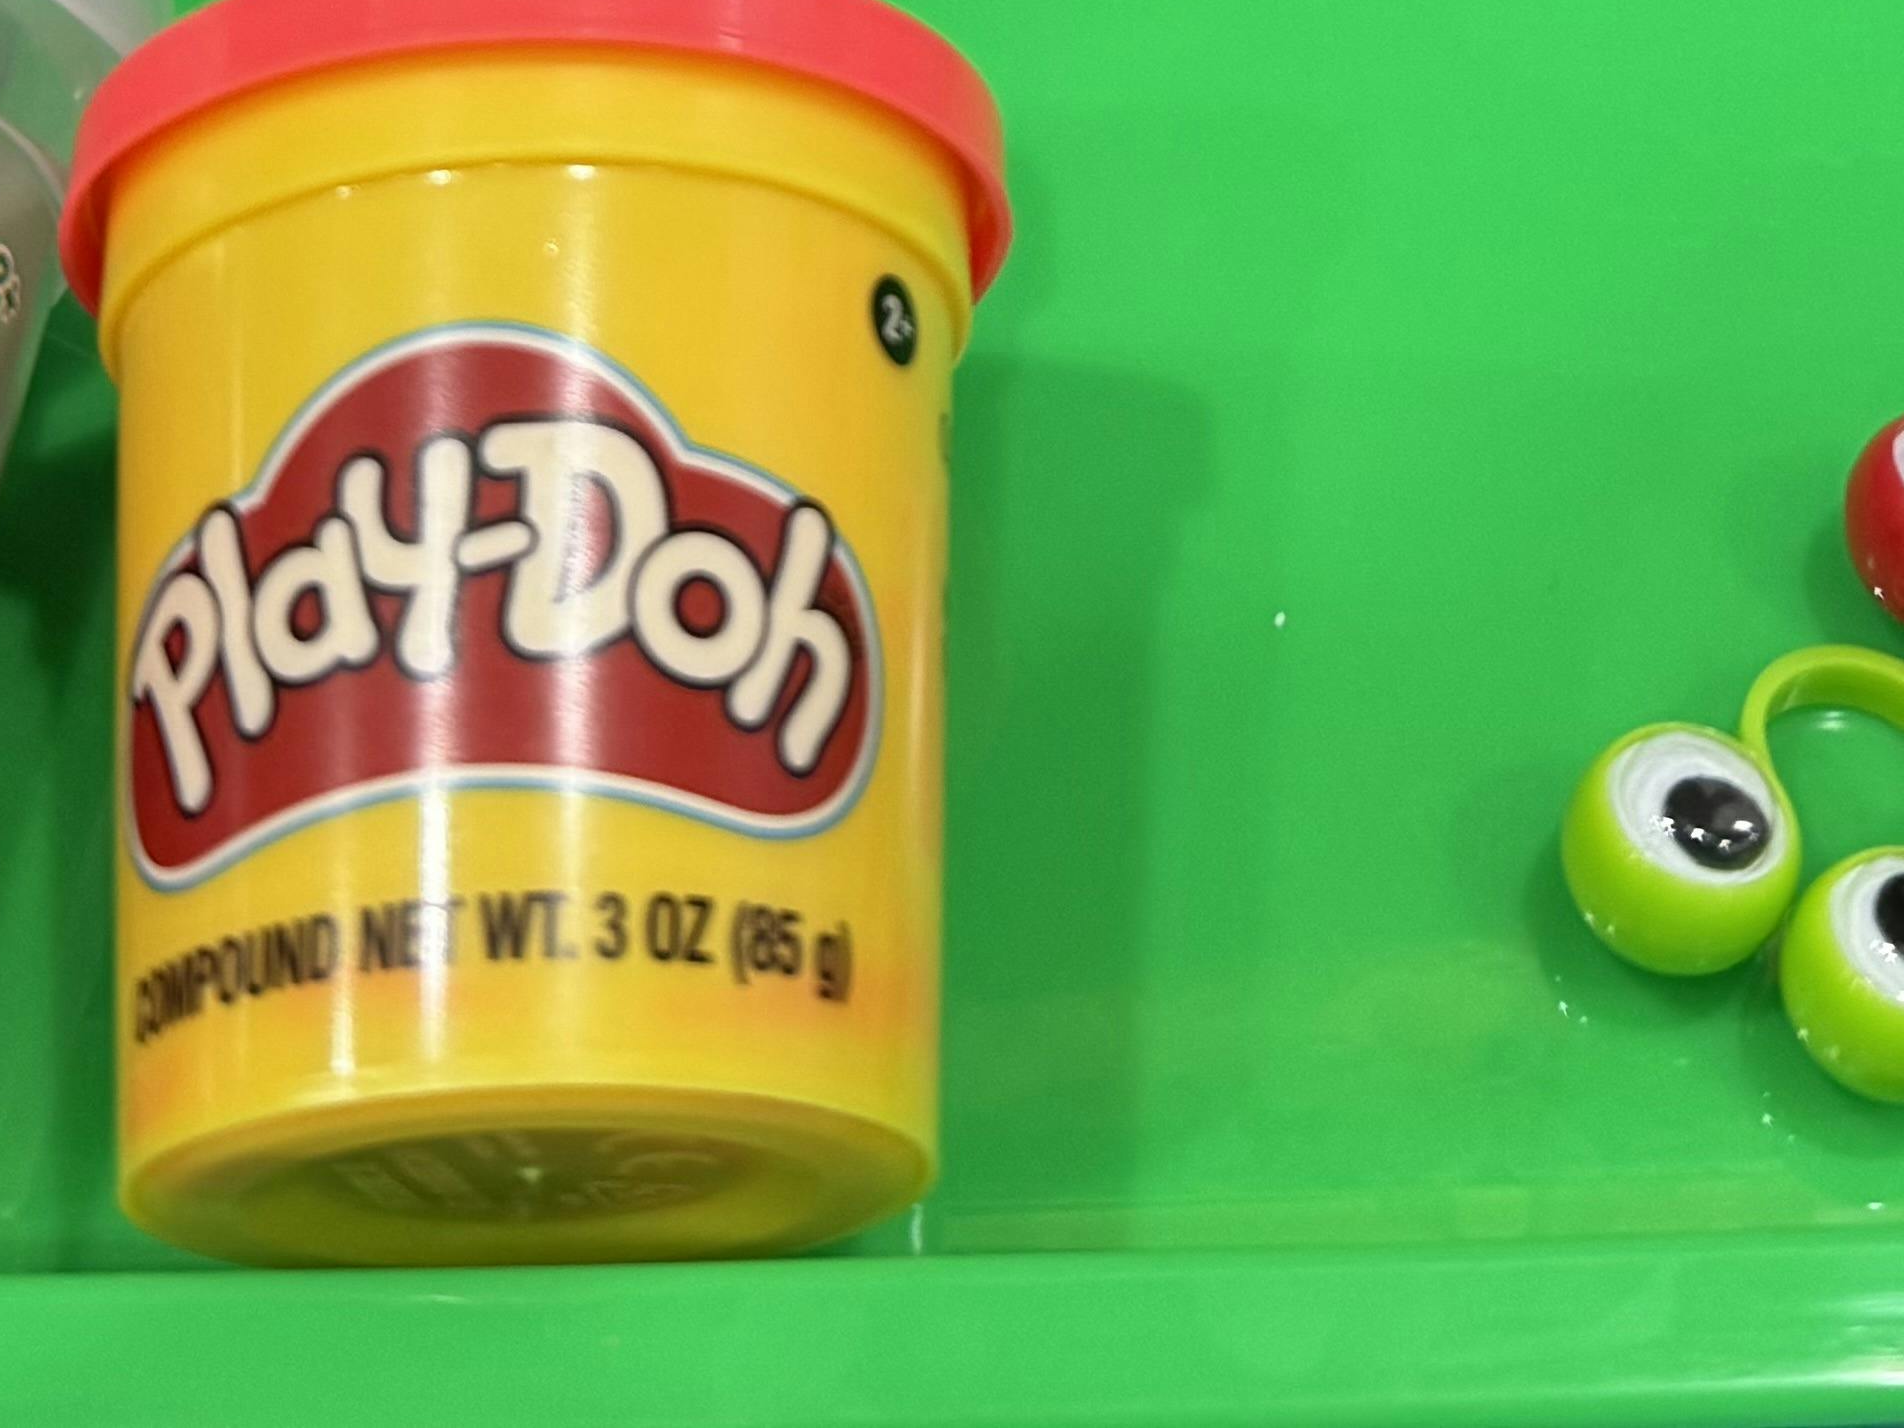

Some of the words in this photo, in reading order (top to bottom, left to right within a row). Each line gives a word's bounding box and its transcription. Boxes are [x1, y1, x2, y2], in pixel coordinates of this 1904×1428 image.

[130, 412, 858, 818] Play-Doh
[134, 912, 339, 1044] COMPOUND
[358, 894, 465, 974] NET
[478, 889, 578, 962] WT.
[593, 892, 629, 961] 3
[645, 892, 715, 965] OZ
[730, 899, 801, 984] (85
[814, 921, 852, 1003] g)
